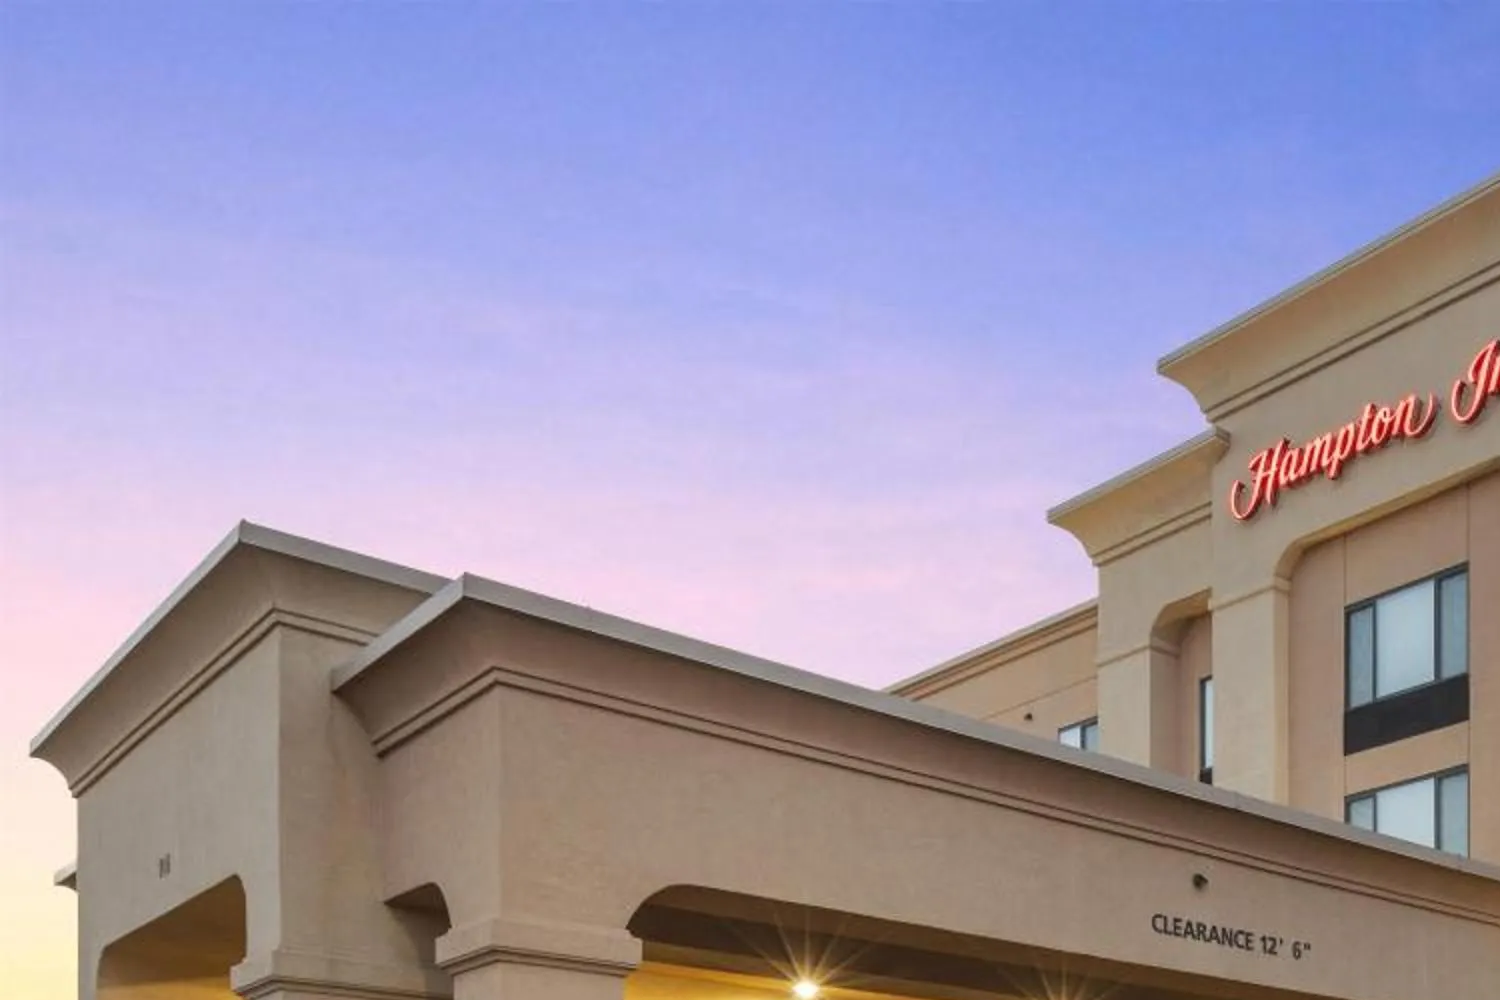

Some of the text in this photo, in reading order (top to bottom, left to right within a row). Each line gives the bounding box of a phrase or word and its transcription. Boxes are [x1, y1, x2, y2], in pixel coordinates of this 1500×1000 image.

[1230, 393, 1438, 521] Hampton
[1151, 913, 1255, 952] CLEARANCE
[1259, 935, 1285, 956] 12'
